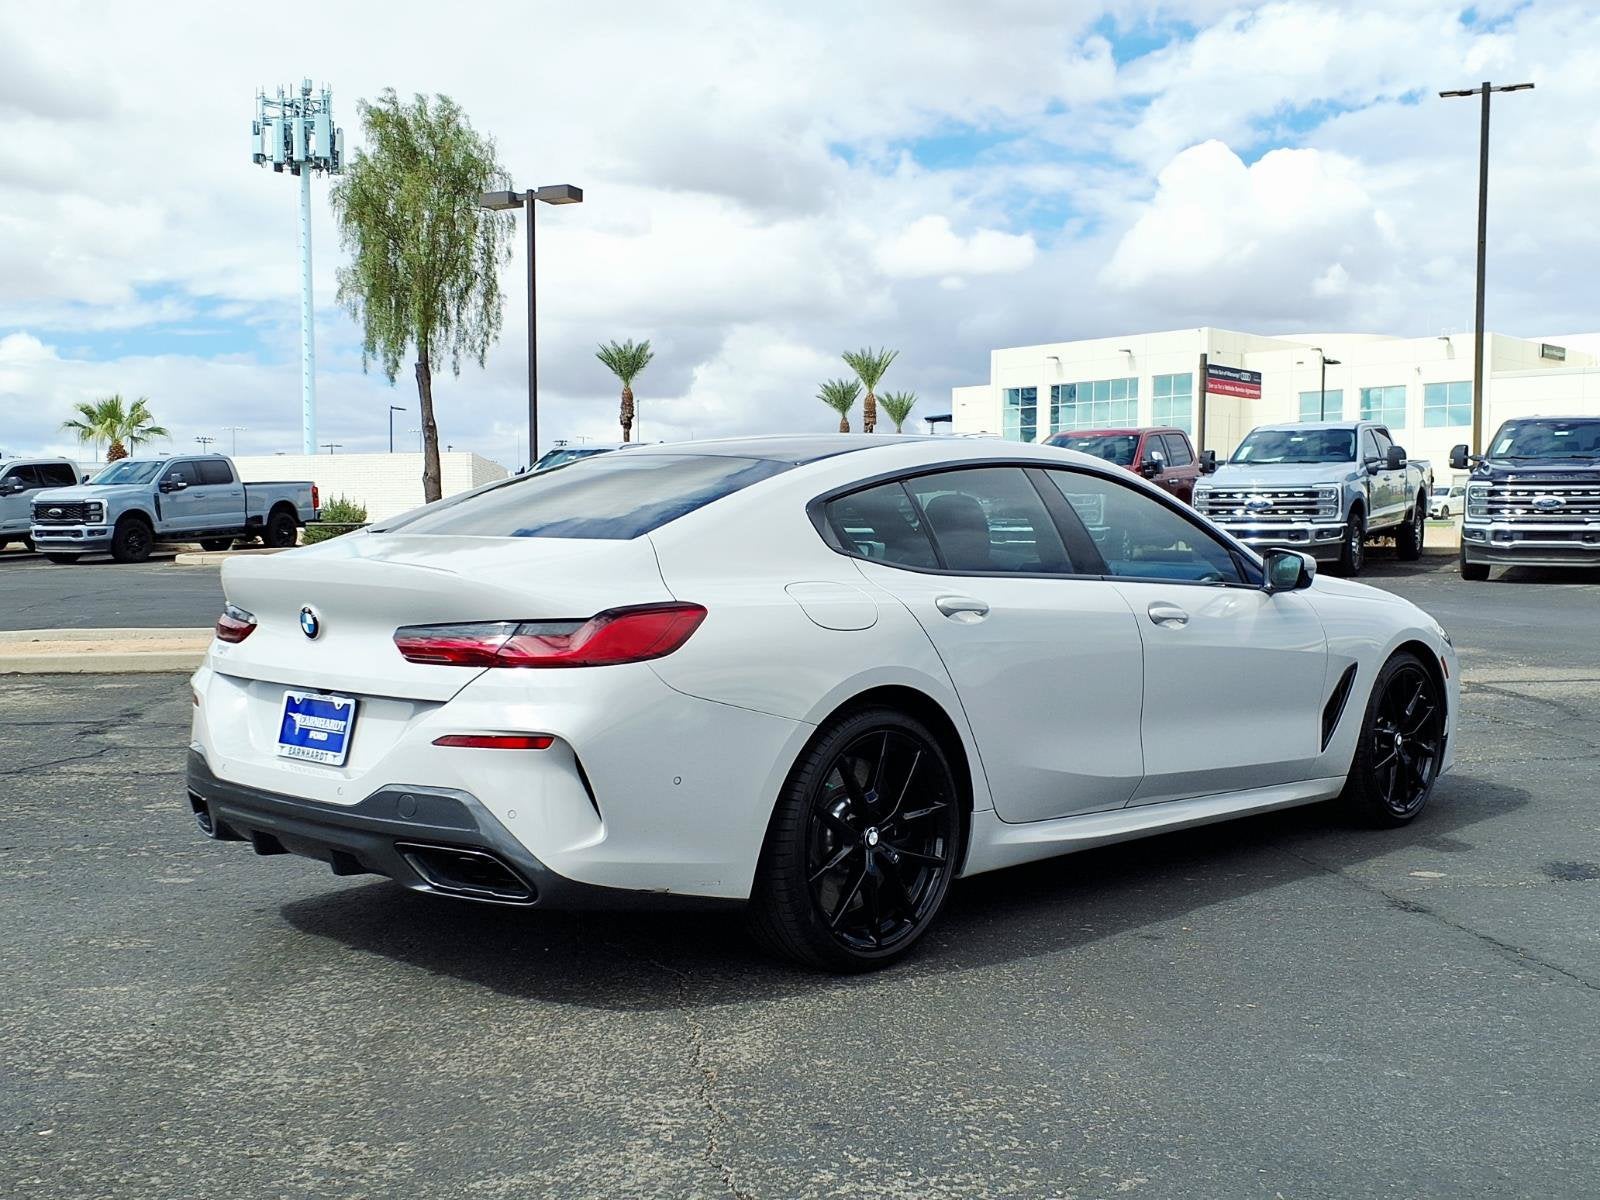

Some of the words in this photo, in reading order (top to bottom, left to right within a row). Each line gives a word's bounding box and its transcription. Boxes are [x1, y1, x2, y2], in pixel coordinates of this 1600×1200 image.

[299, 714, 346, 731] EARNHARDT
[309, 730, 328, 741] FORD
[288, 746, 329, 761] EARNHARDT
